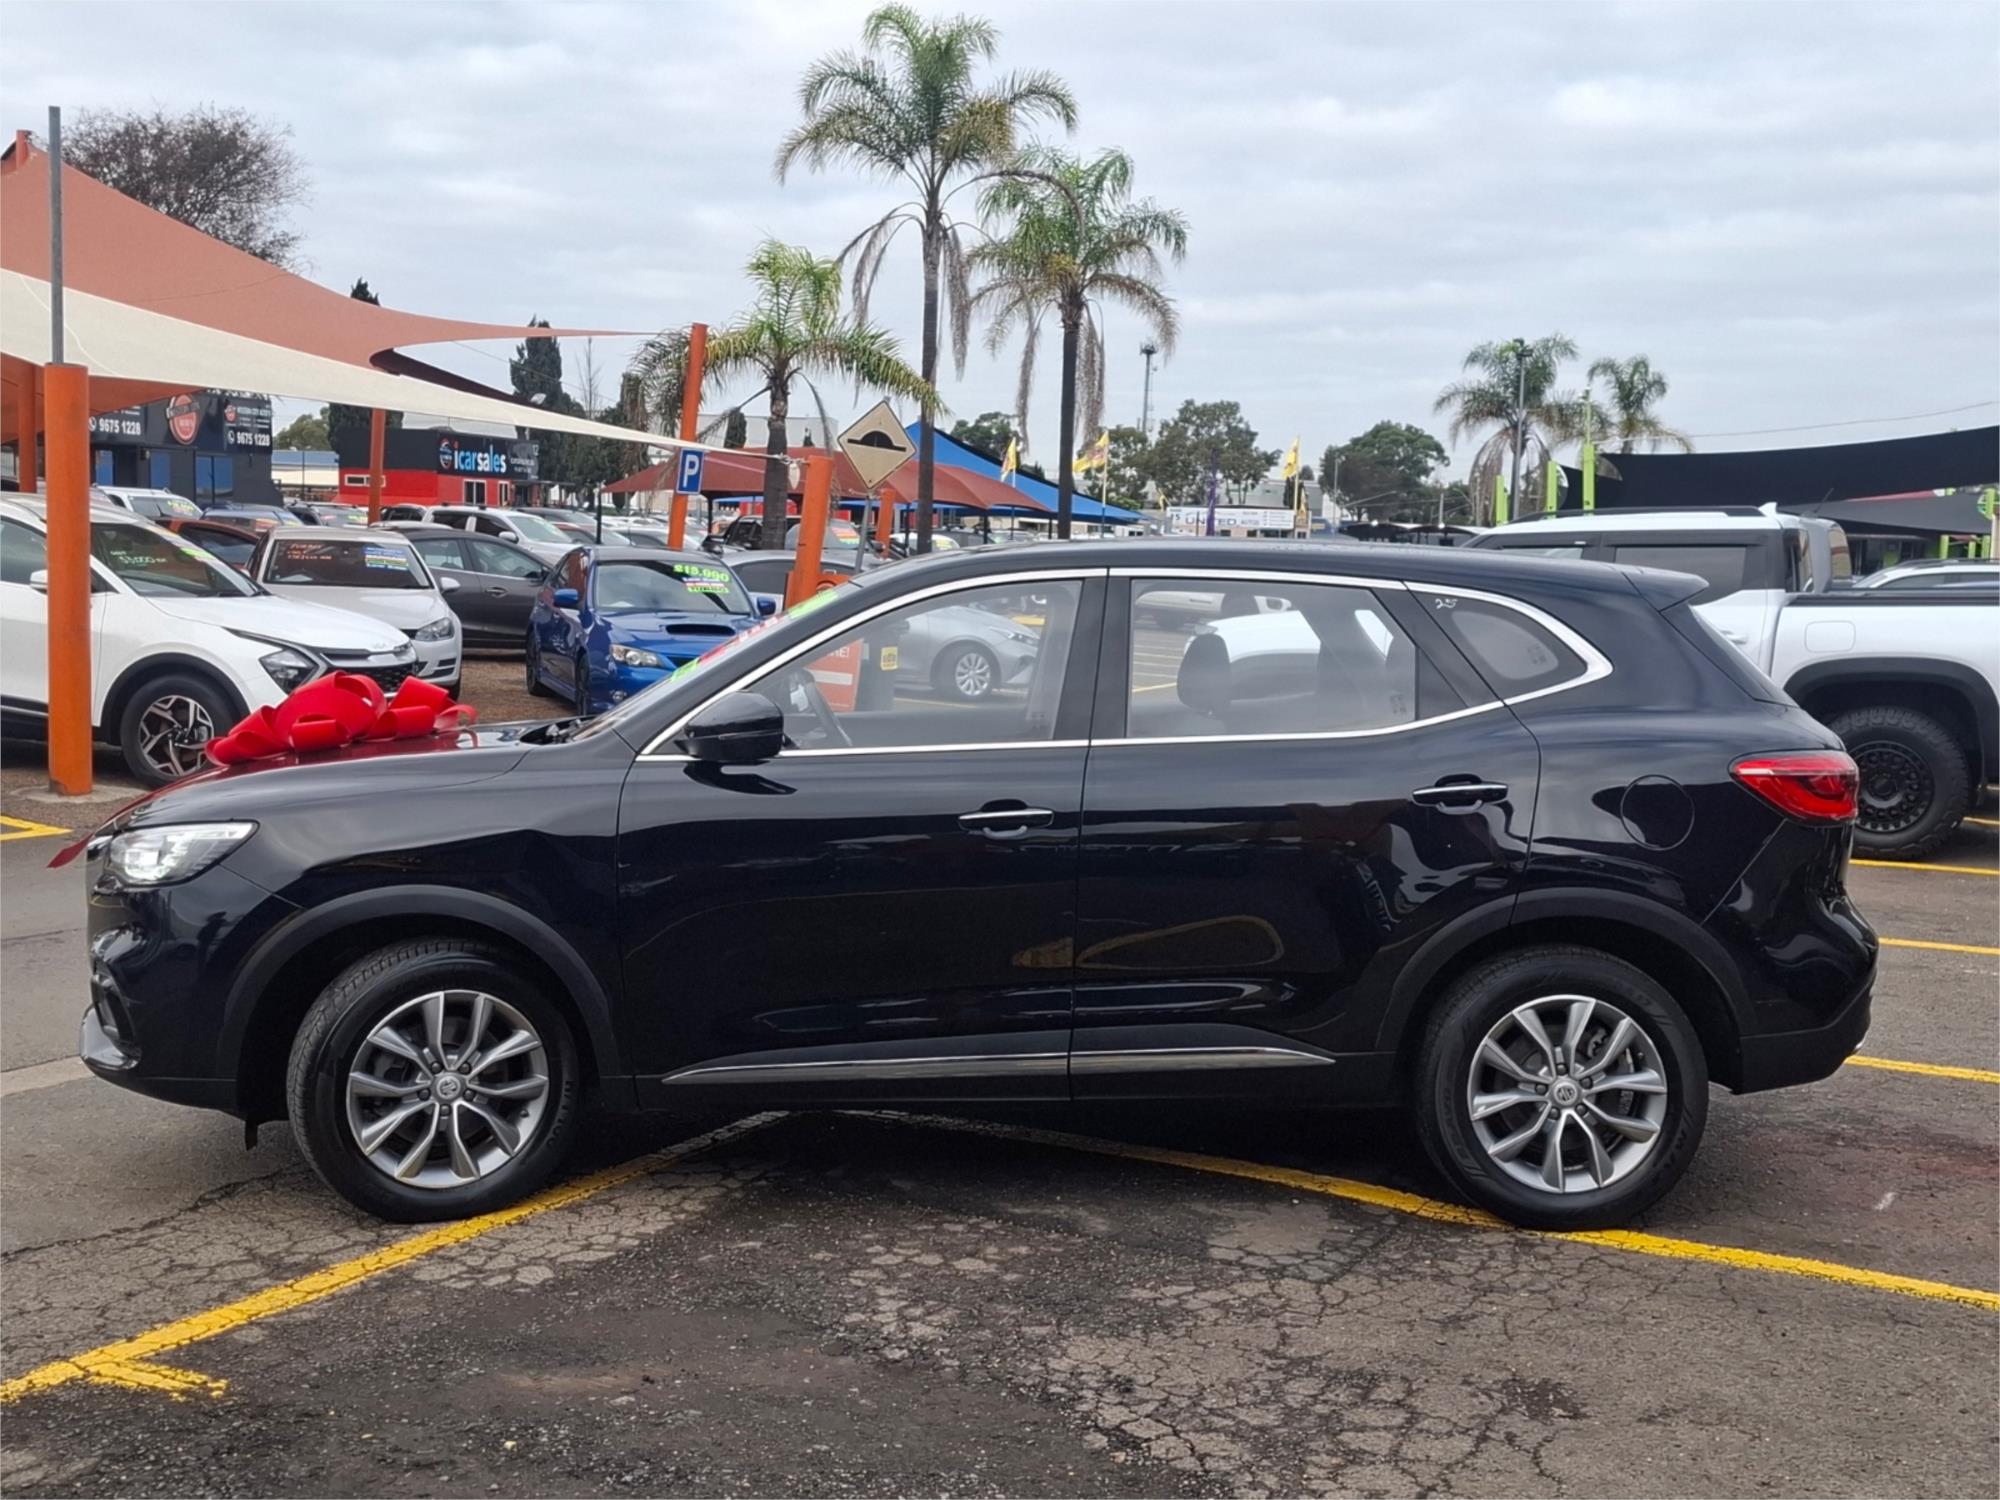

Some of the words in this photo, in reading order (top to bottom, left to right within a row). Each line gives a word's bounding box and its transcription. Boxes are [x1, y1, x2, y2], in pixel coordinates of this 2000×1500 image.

[98, 418, 120, 434] 9675
[122, 420, 141, 436] 1228
[453, 440, 507, 474] icarsales
[682, 454, 700, 488] P
